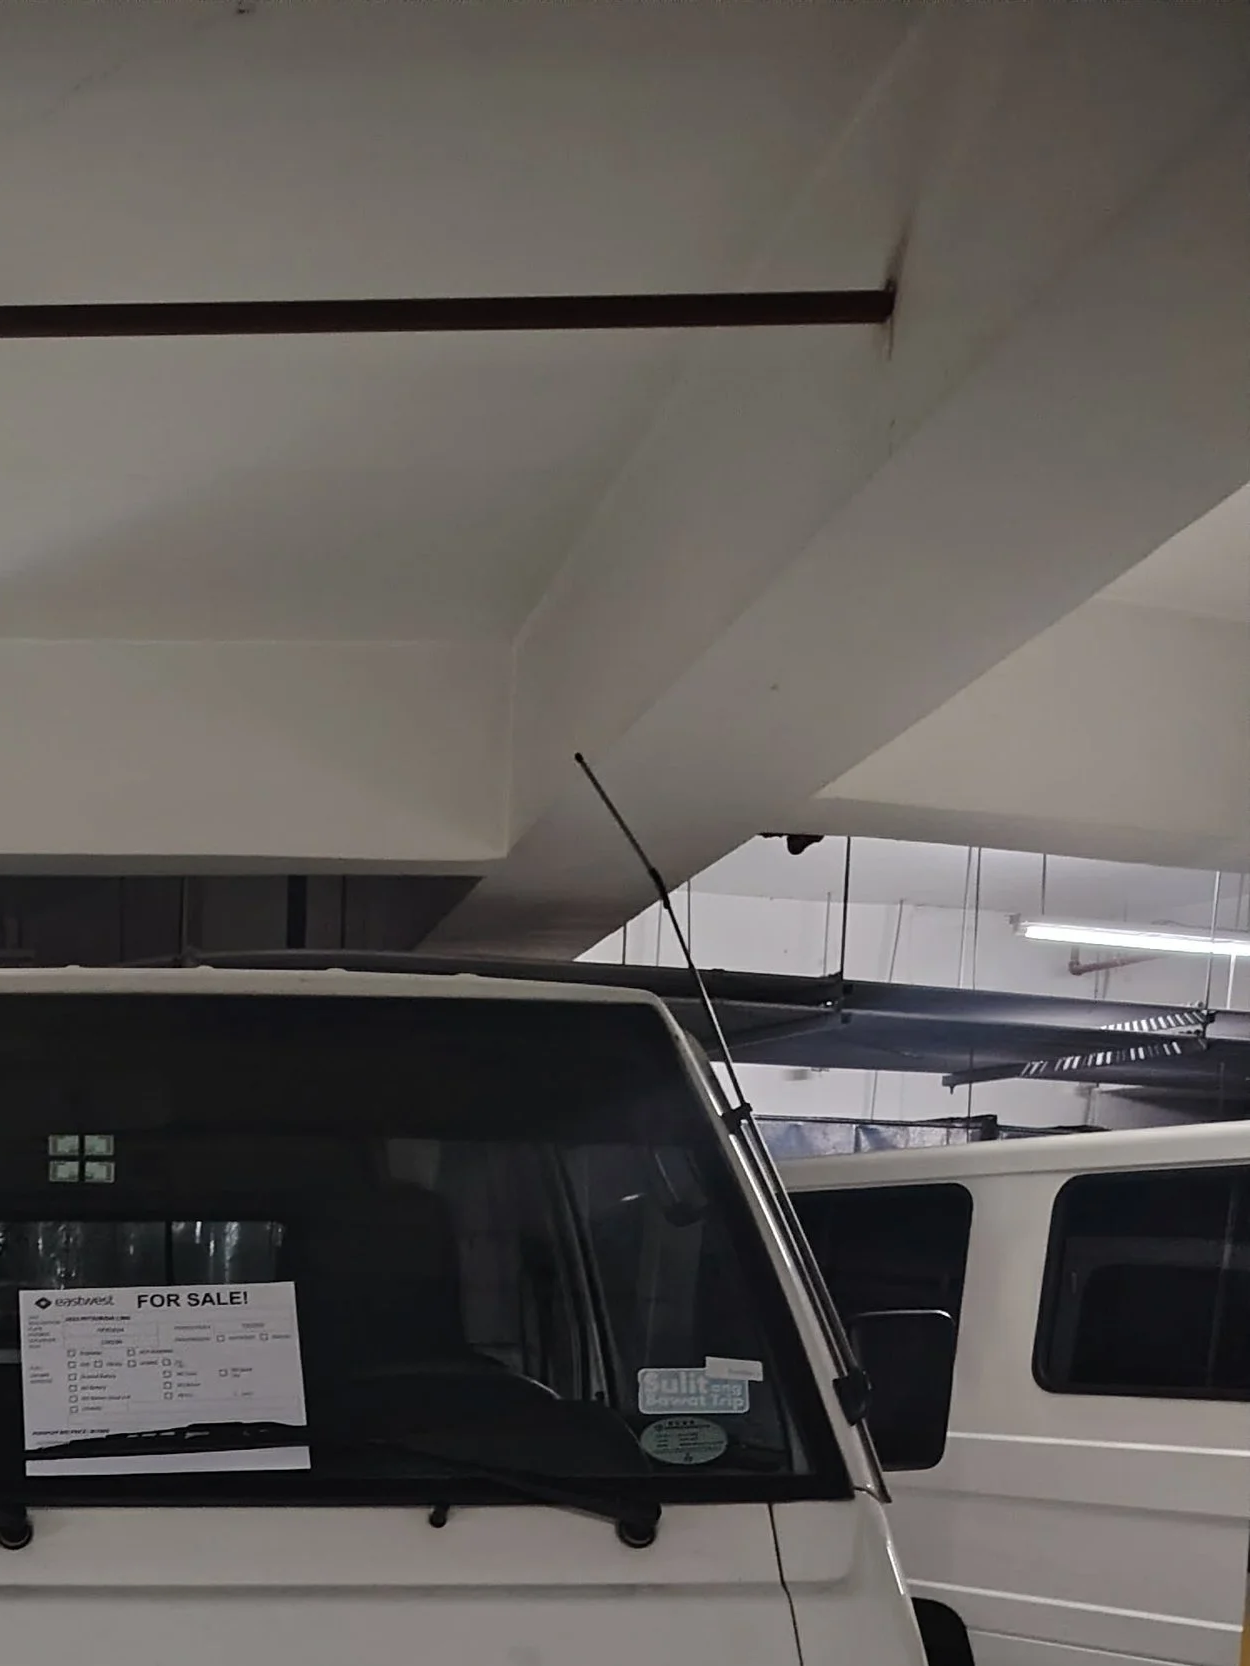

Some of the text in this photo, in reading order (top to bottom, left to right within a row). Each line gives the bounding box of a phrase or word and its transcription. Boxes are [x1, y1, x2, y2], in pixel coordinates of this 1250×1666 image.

[55, 1291, 248, 1309] eastwest FOR SALE!
[643, 1370, 709, 1395] Sulit
[711, 1383, 743, 1397] ang
[645, 1394, 745, 1411] Bawat Trip
